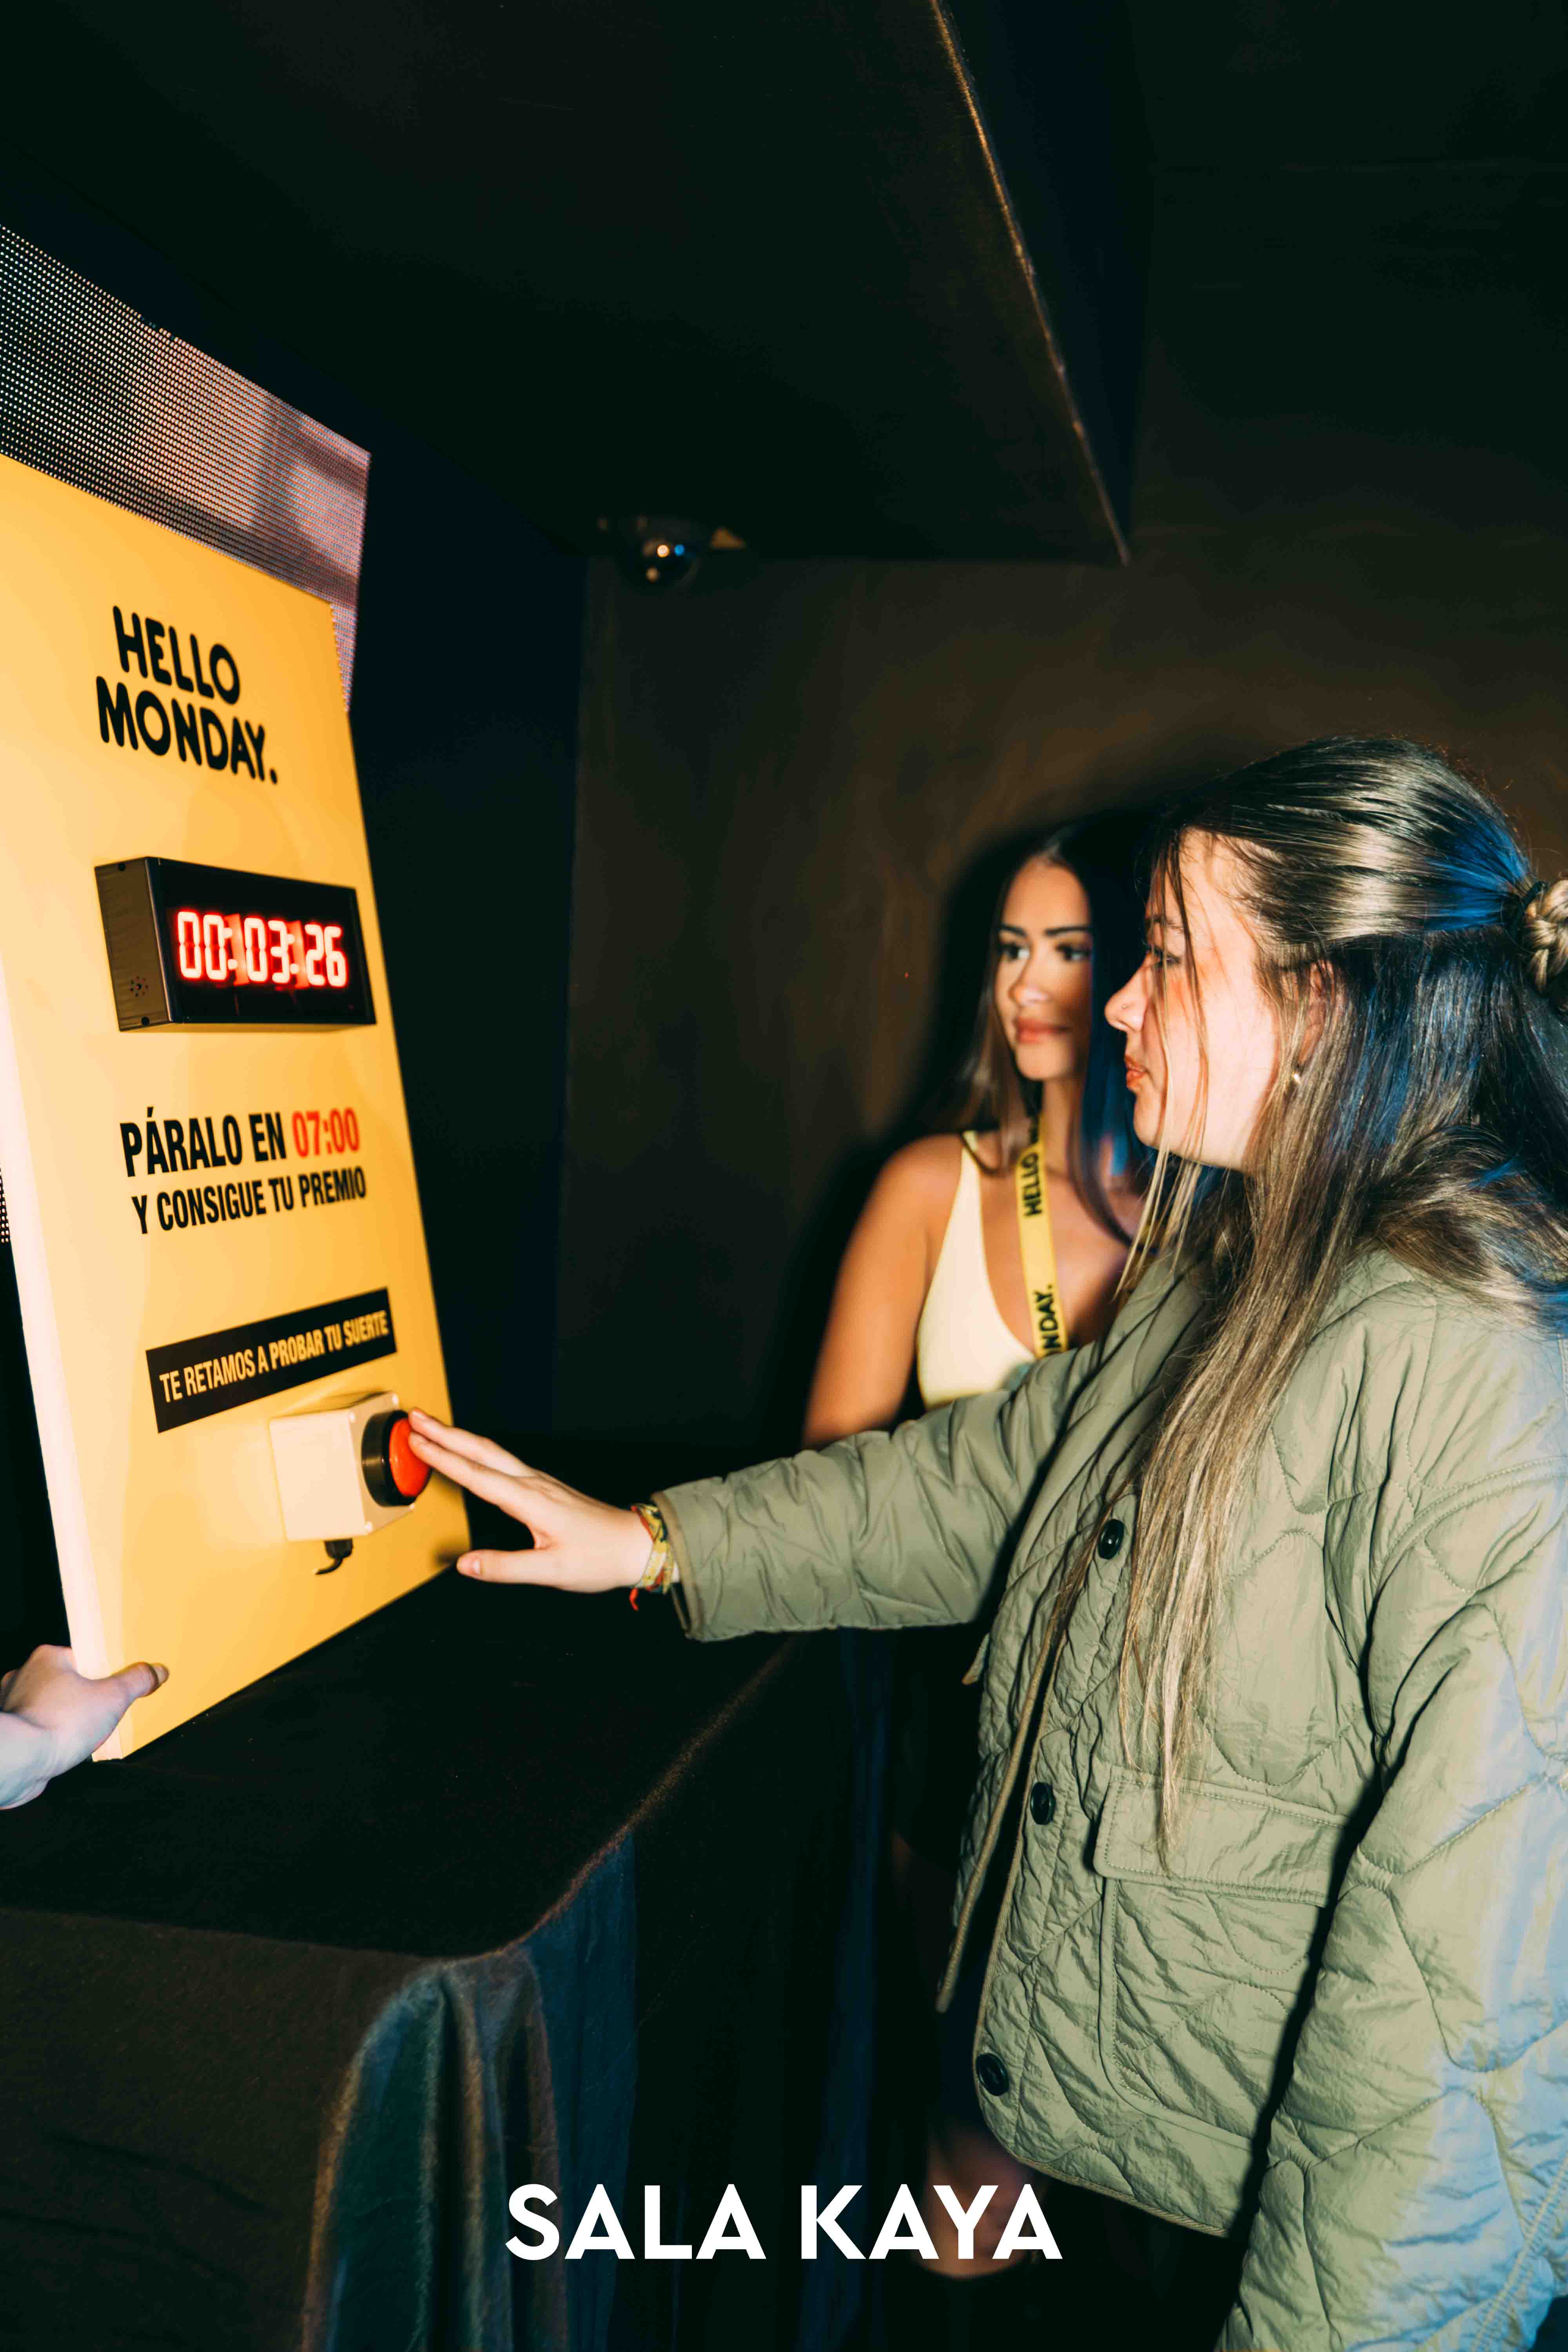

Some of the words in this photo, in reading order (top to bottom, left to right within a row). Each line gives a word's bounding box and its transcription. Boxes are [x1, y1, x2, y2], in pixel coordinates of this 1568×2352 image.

[113, 605, 240, 705] HELLO
[95, 675, 278, 785] MONDAY.
[176, 910, 348, 987] 00:03:26
[120, 1107, 243, 1178] PÁRALO
[249, 1111, 287, 1162] EN
[292, 1107, 360, 1158] 07:00
[131, 1195, 148, 1235] Y
[156, 1179, 267, 1232] CONSIGUE
[269, 1174, 294, 1212] TU
[298, 1165, 367, 1209] PREMIO
[1020, 1152, 1042, 1217] HELLO
[160, 1370, 183, 1403] TE
[185, 1349, 256, 1397] RETAMOS
[257, 1346, 269, 1373] A
[269, 1329, 323, 1370] PROBAR
[324, 1324, 343, 1351] TU
[343, 1310, 388, 1347] SUERTE
